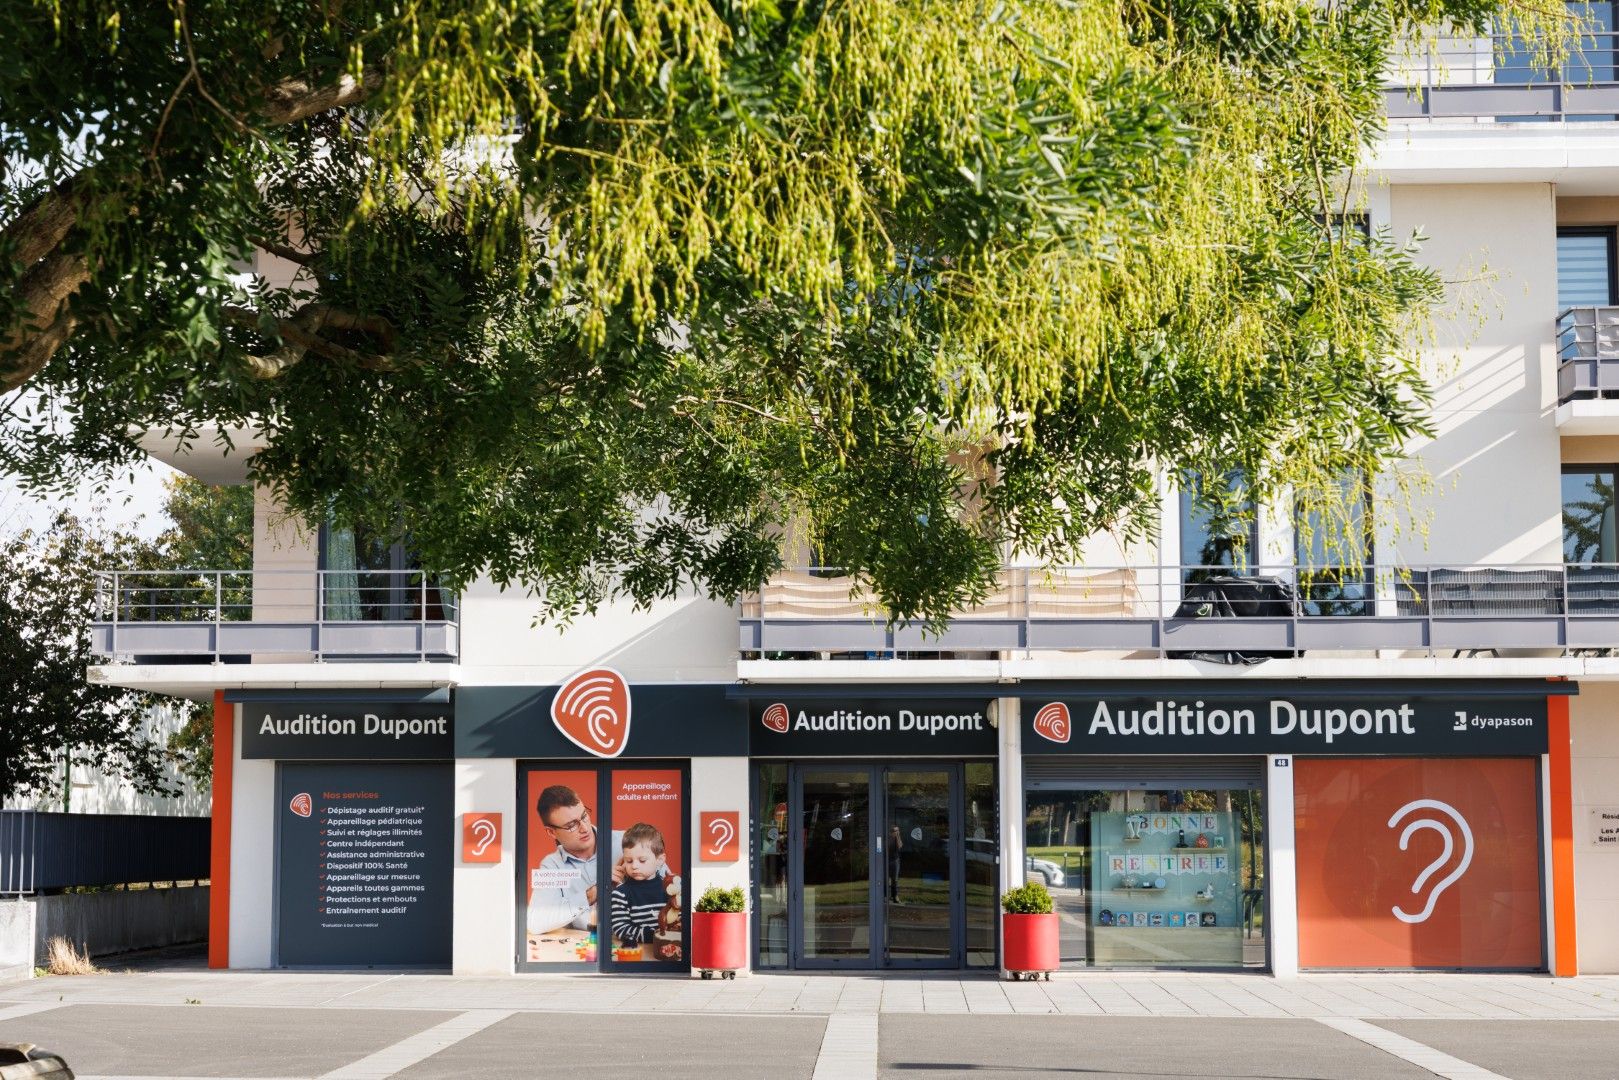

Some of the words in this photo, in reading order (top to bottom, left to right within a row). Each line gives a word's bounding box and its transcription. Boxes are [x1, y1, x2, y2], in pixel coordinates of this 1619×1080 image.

[259, 714, 355, 734] Audition
[364, 714, 447, 739] Dupont
[794, 710, 891, 730] Audition
[899, 710, 983, 735] Dupont
[1089, 701, 1255, 735] Audition
[1270, 701, 1415, 743] Dupont
[1471, 715, 1532, 729] dyapason
[623, 782, 671, 791] Appareillage
[1140, 816, 1214, 829] BONNE
[355, 840, 404, 848] indépendant
